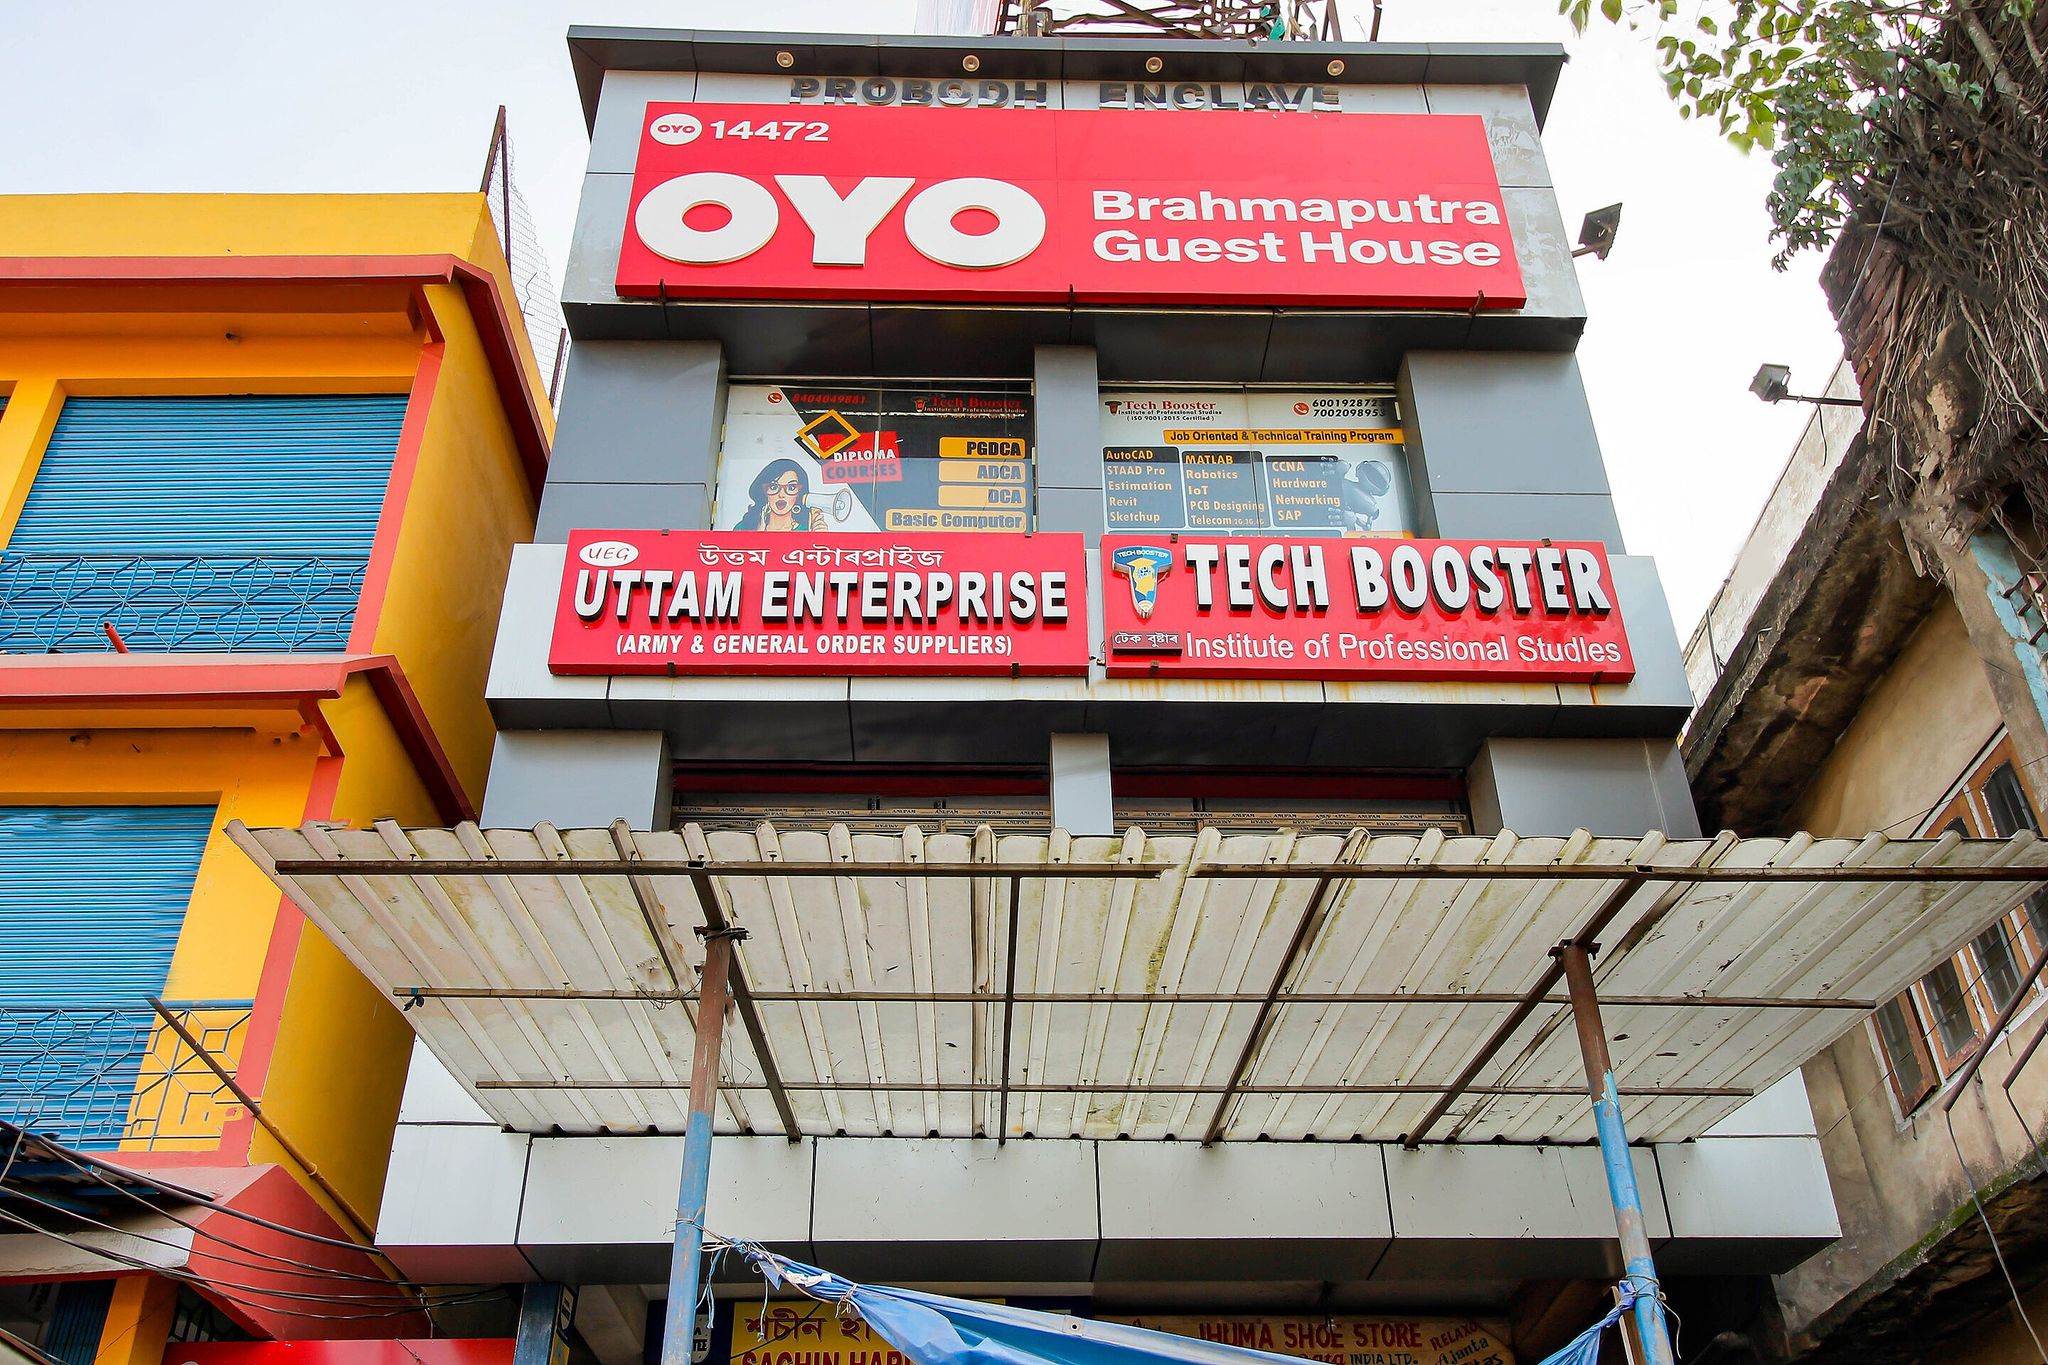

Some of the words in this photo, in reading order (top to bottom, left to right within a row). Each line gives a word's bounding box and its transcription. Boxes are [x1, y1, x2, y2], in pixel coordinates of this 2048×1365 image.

[789, 77, 1047, 109] PROBODH
[1099, 82, 1342, 112] ENCLAVE
[657, 124, 696, 134] OYO
[710, 120, 830, 142] 14472
[1092, 190, 1501, 230] Brahmaputra
[635, 172, 1047, 270] OYO
[1092, 229, 1287, 263] Guest
[1300, 231, 1501, 266] House
[1122, 400, 1157, 410] Tech
[1162, 400, 1217, 410] Booster
[1170, 431, 1190, 441] Job
[1192, 430, 1239, 441] Oriented
[1241, 432, 1250, 441] &
[1251, 431, 1302, 441] Technical
[1304, 431, 1348, 443] Training
[1349, 432, 1395, 443] Program
[966, 441, 1022, 456] PGDCA
[1105, 450, 1154, 460] AutoCAD
[833, 449, 896, 463] DIPLOMA
[1184, 454, 1234, 465] MATLAB
[825, 463, 897, 480] COURSES
[976, 464, 1022, 480] ADCA
[1106, 465, 1143, 475] STAAD
[1146, 466, 1166, 476] Pro
[1271, 461, 1305, 472] CCNA
[1186, 469, 1238, 480] Robotics
[1108, 480, 1173, 491] Estimation
[1188, 485, 1209, 495] IoT
[1272, 478, 1328, 488] Hardware
[987, 488, 1022, 504] DCA
[1109, 497, 1137, 507] Revit
[1275, 495, 1341, 508] Networking
[1190, 500, 1210, 511] PCB
[1213, 500, 1265, 513] Designing
[891, 511, 938, 527] Basic
[940, 512, 1022, 530] Computer
[1110, 511, 1161, 523] Sketchup
[1191, 514, 1232, 525] Telecom
[1277, 510, 1302, 521] SAP
[588, 547, 631, 561] UEG
[698, 542, 771, 566] উত্তম
[1117, 550, 1136, 558] TECH
[1136, 549, 1169, 559] BOOSTER
[1184, 543, 1328, 610] TECH
[1350, 545, 1612, 615] BOOSTER
[574, 569, 743, 622] UTTAM
[761, 570, 1069, 625] ENTERPRISE
[1114, 631, 1142, 644] টেক
[616, 634, 683, 655] (ARMY
[690, 635, 705, 654] &
[713, 634, 809, 655] GENERAL
[816, 635, 886, 655] ORDER
[893, 635, 1013, 657] SUPPLIERS)
[1186, 631, 1295, 659] Institute
[1304, 633, 1331, 659] of
[1338, 633, 1510, 662] Professional
[1517, 635, 1623, 663] Studies
[743, 1307, 828, 1342] শচীন
[1283, 1322, 1345, 1348] SHOE
[1353, 1322, 1423, 1348] STORE
[1429, 1319, 1479, 1351] RELAXO
[1435, 1337, 1490, 1365] Ajanta
[1349, 1353, 1385, 1365] INDIA
